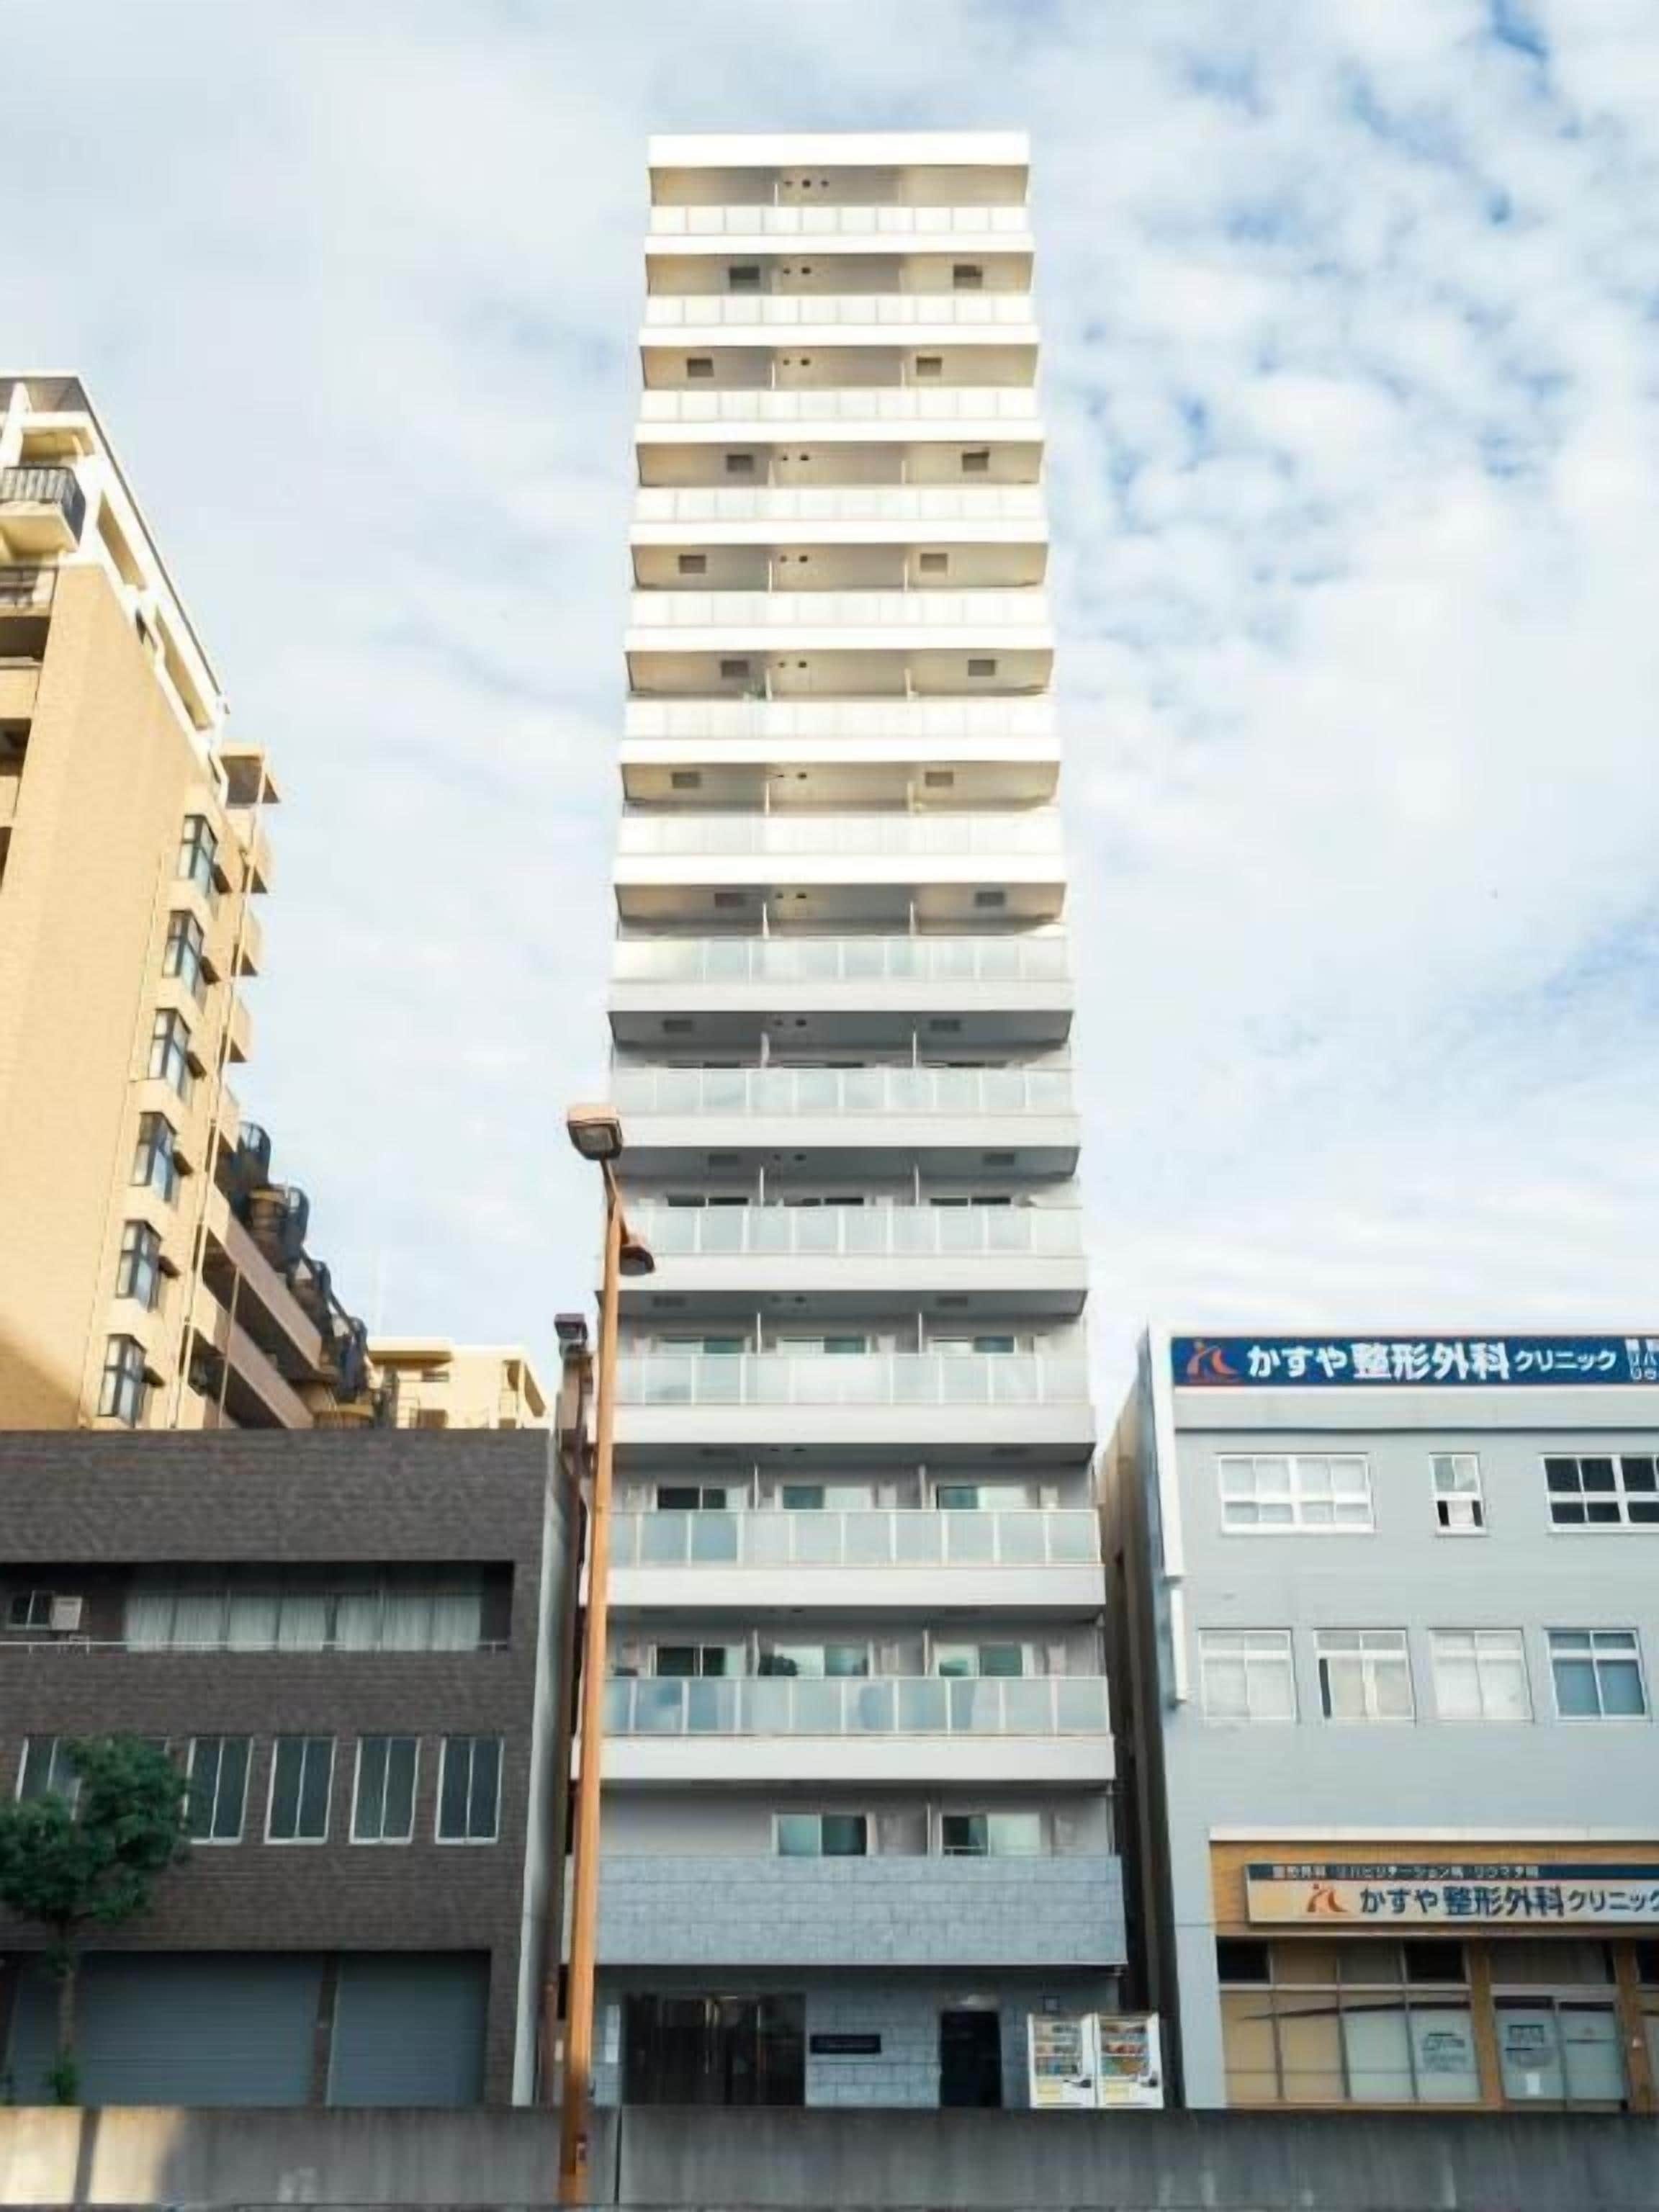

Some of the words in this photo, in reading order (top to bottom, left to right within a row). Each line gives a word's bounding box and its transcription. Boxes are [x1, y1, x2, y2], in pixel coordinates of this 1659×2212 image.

[1247, 1342, 1617, 1380] かすや整形外科クリニック
